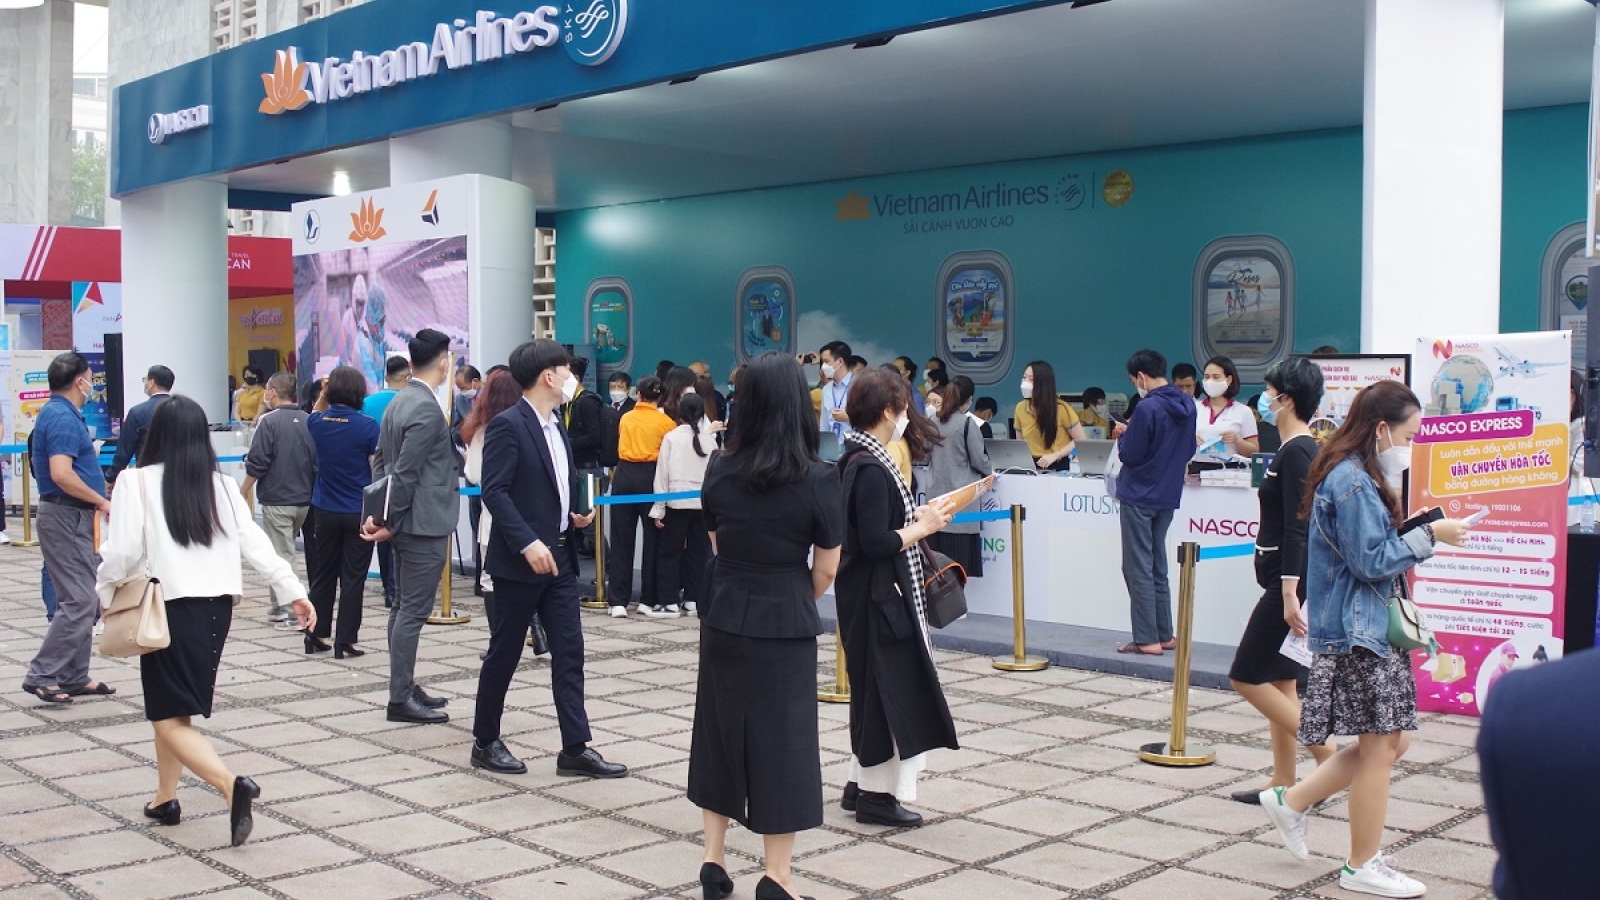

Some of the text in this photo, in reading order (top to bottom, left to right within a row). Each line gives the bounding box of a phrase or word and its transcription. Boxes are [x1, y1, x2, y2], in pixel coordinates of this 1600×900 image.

[307, 6, 560, 103] Vietnam Airlines
[873, 183, 1049, 217] Vietnam Airlines
[990, 214, 1014, 228] CAO
[1421, 416, 1523, 436] NASCO EXPRESS
[1440, 448, 1460, 459] Luôn
[1535, 437, 1564, 450] mạnh
[1451, 461, 1469, 479] VẬN
[1531, 449, 1552, 467] TỐC
[1501, 473, 1526, 486] hàng
[1528, 469, 1558, 482] không
[1491, 503, 1521, 512] 19001106
[1530, 567, 1550, 577] tiếng
